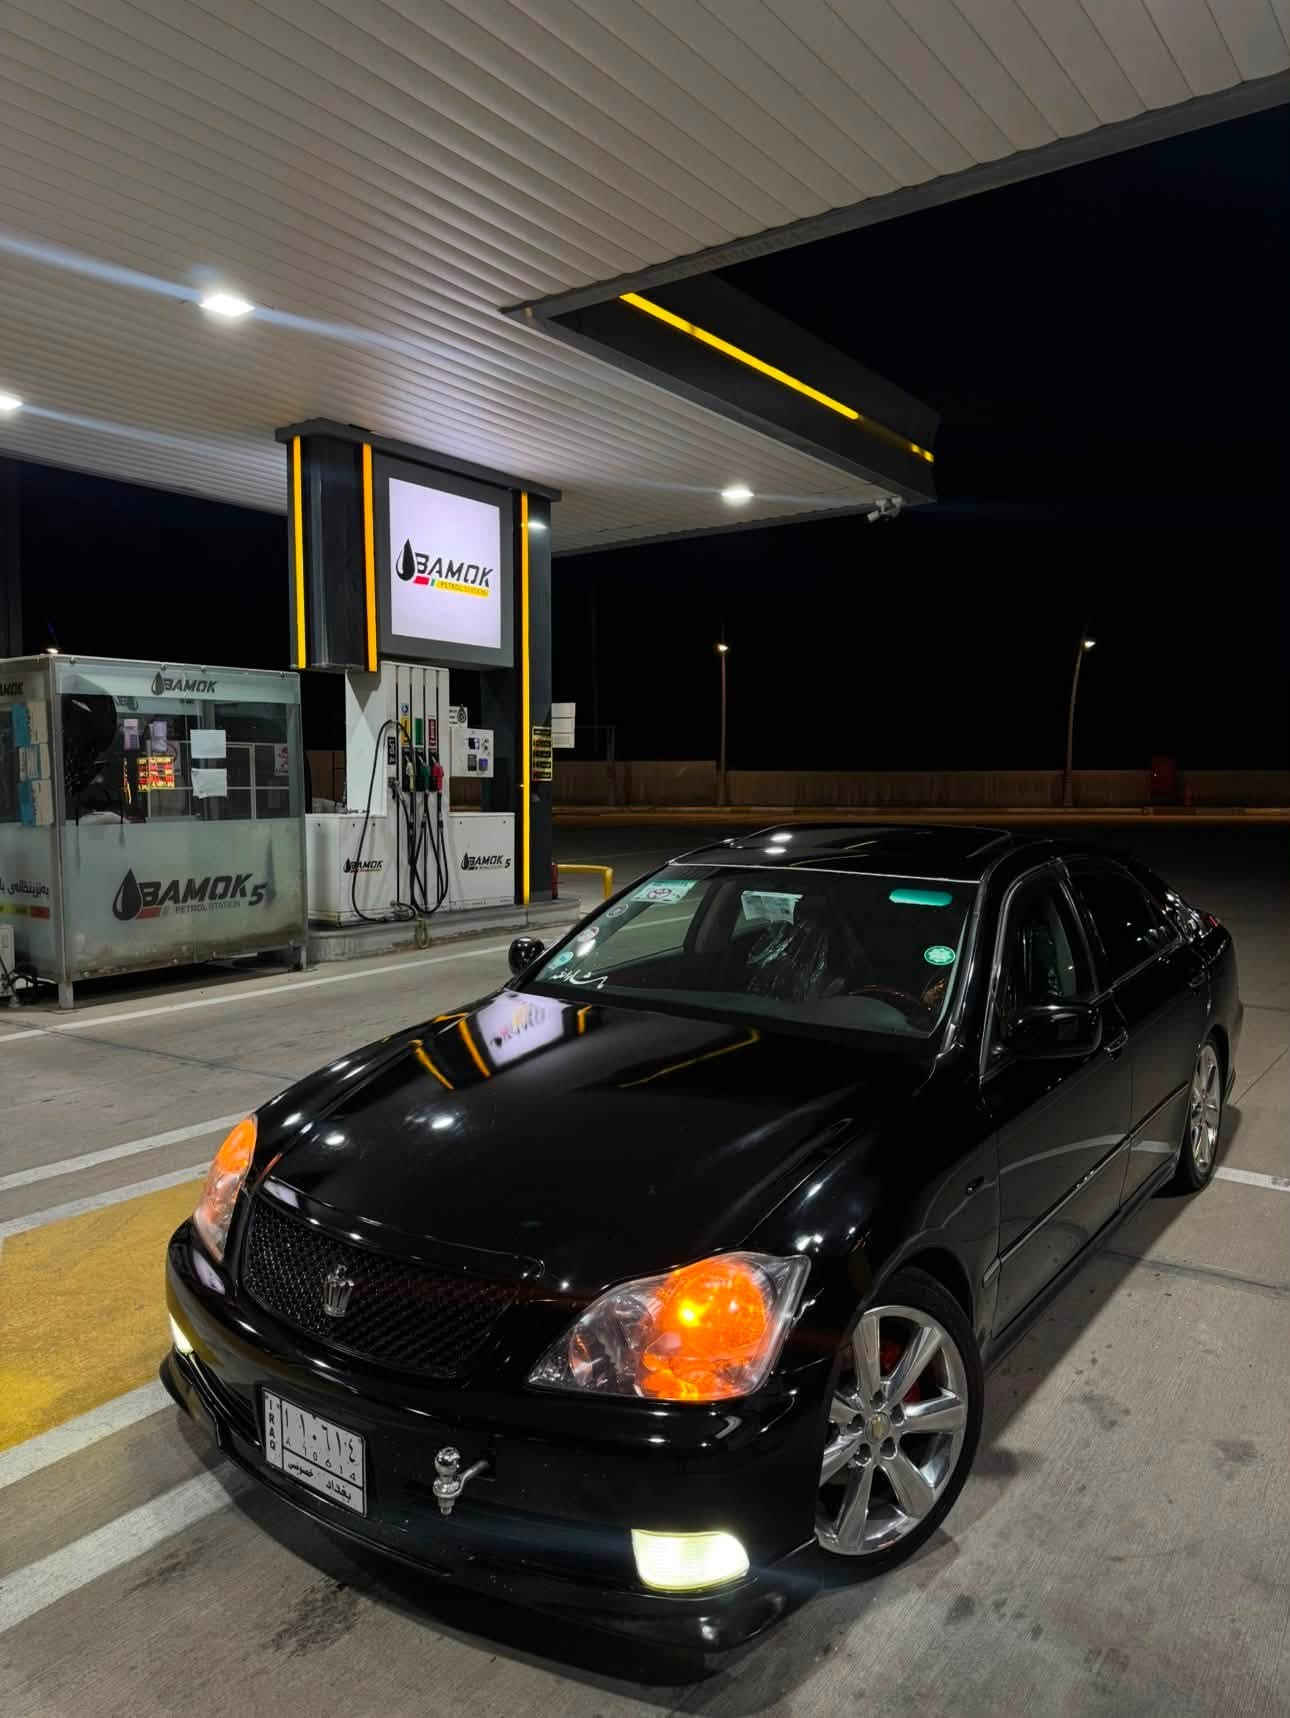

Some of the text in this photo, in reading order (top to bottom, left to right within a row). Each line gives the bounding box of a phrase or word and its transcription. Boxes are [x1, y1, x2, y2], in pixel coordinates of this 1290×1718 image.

[415, 552, 494, 588] BAMOK
[164, 679, 217, 694] BAMOK
[504, 857, 512, 869] 5
[139, 873, 268, 906] BAMOK 5
[268, 1399, 277, 1451] IRAQ
[326, 1479, 352, 1503] بغداد
